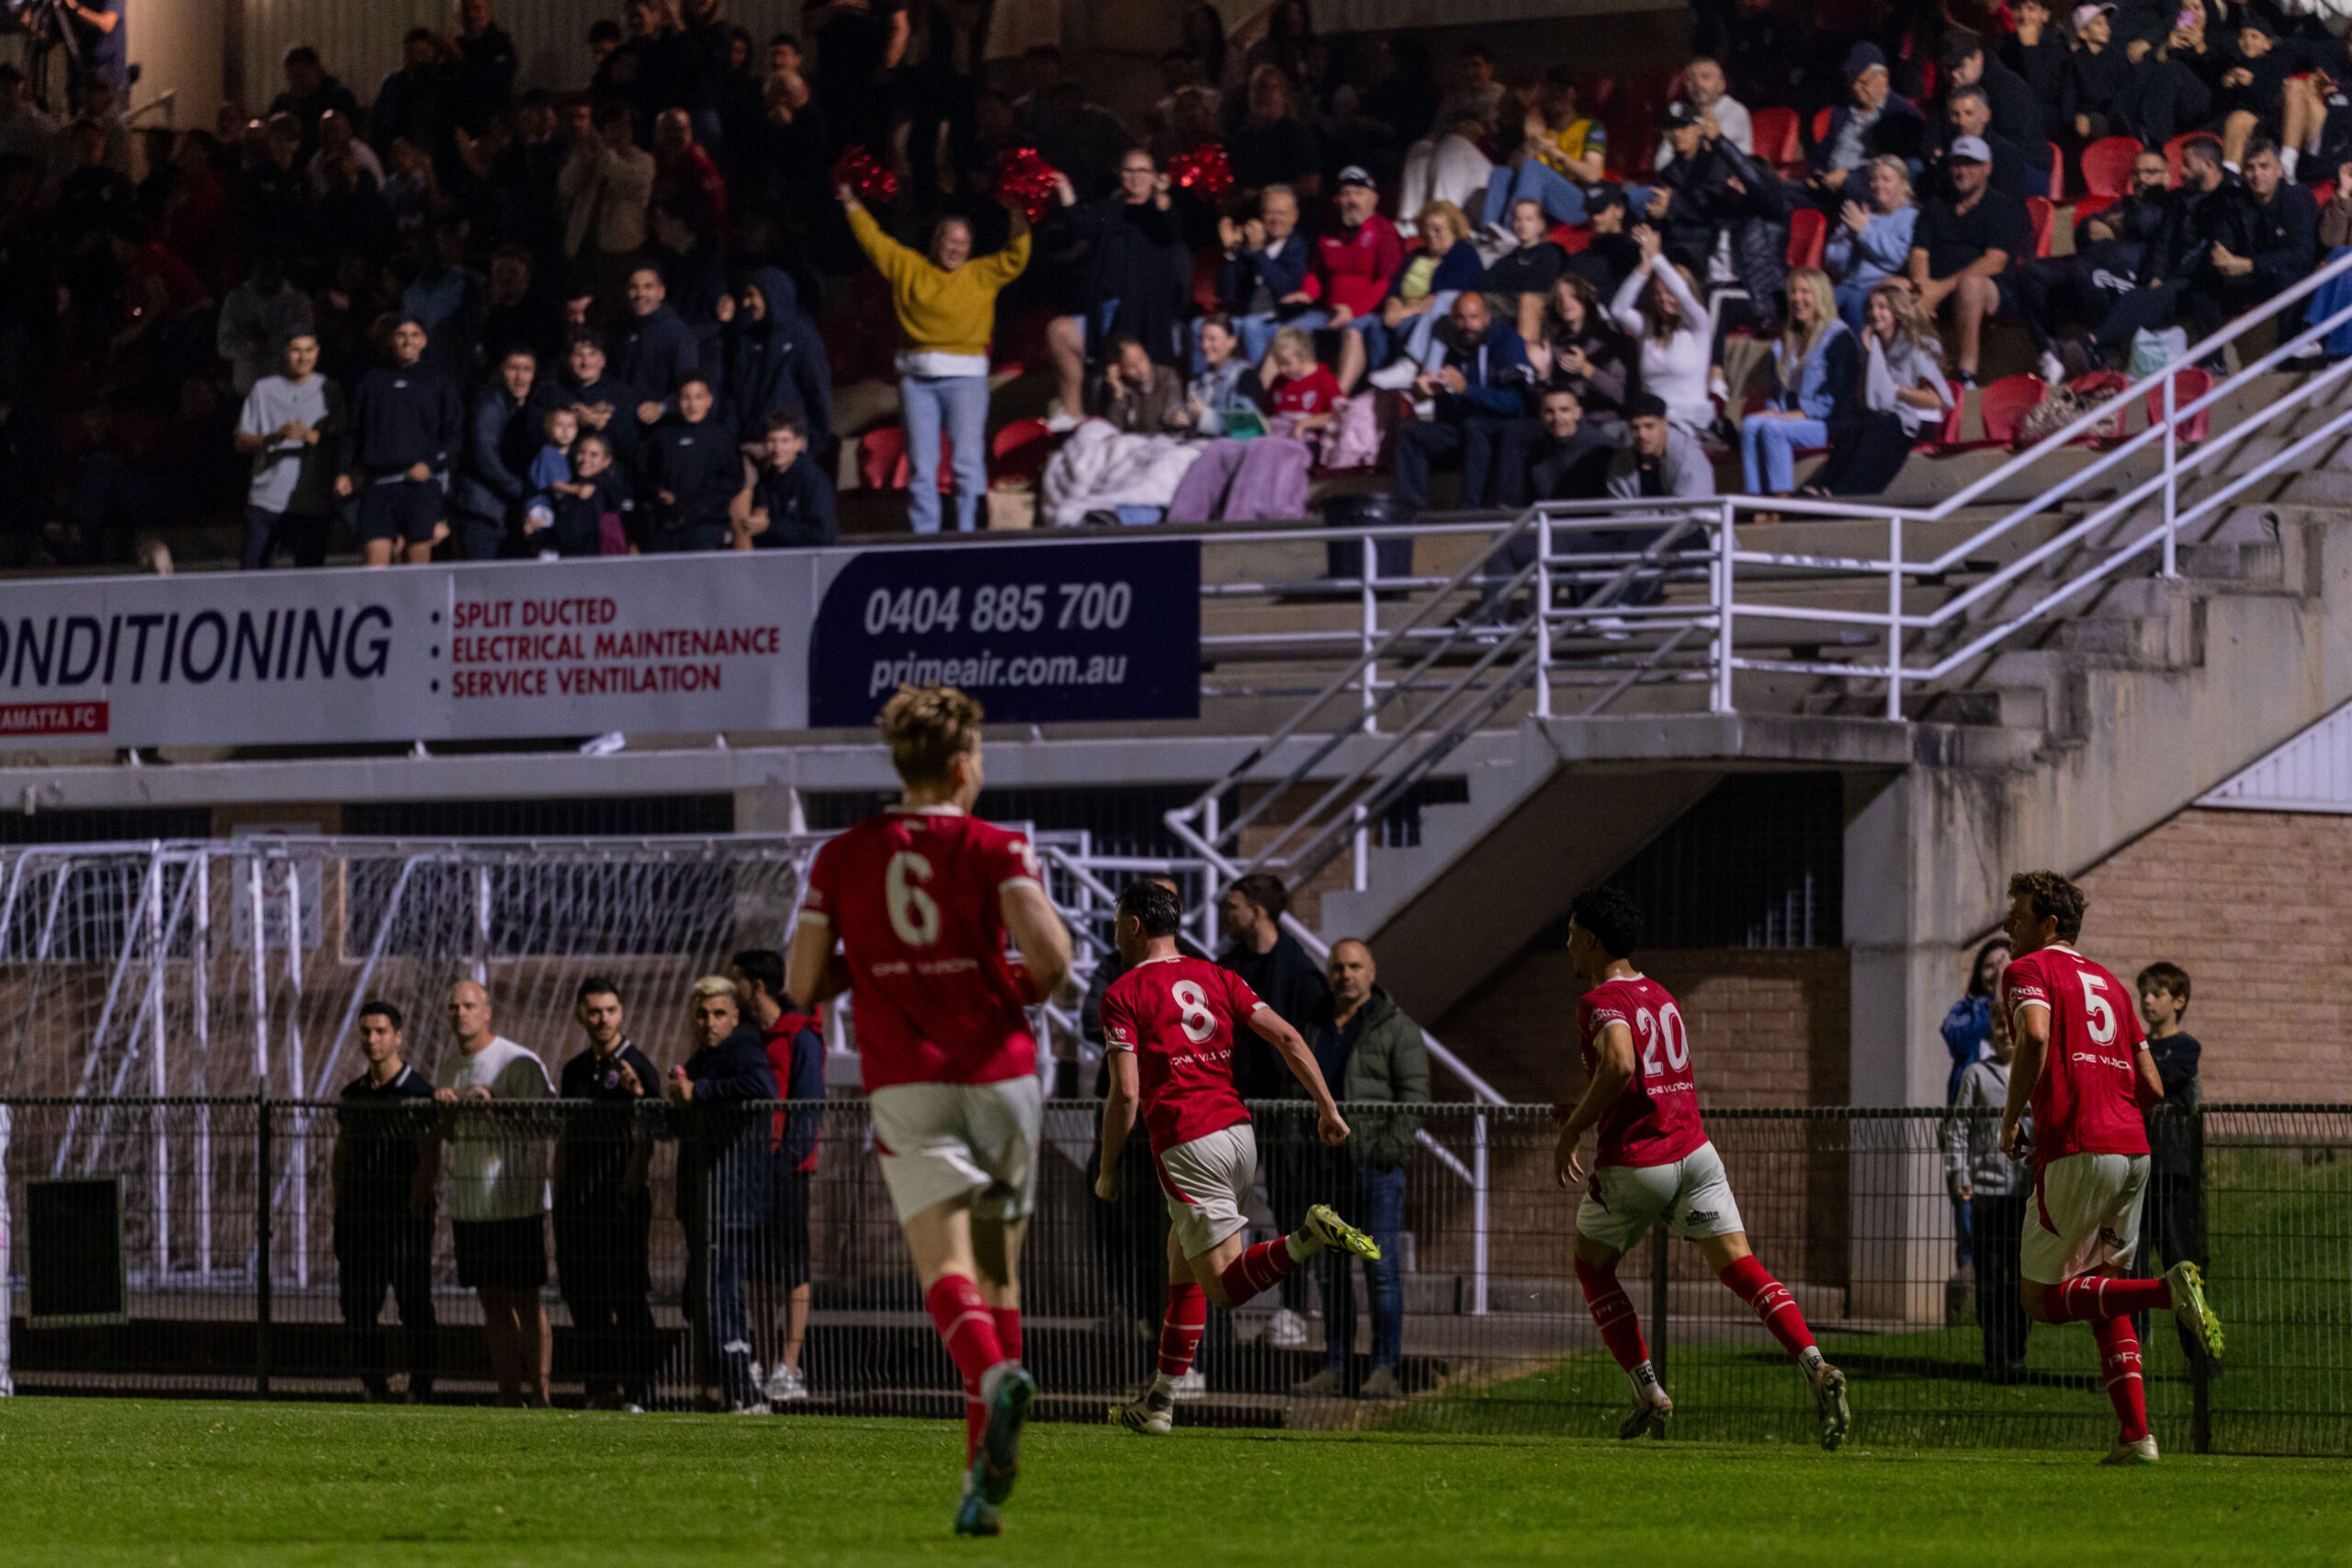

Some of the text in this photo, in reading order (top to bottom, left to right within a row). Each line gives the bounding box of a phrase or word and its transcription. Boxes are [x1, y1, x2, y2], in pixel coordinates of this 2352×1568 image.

[453, 598, 616, 629] SPLIT DUCTED
[865, 581, 1132, 635] 0404 885 700
[0, 605, 392, 686] NDITIONING
[453, 626, 780, 662] ELECTRICAL MAINTENANCE
[453, 663, 721, 698] SERVICE VENTILATION
[869, 649, 1127, 698] primeair.com.au
[0, 706, 96, 729] AMATTA FC
[886, 851, 942, 947] 6
[1172, 979, 1218, 1044] 8
[2076, 970, 2118, 1046] 5
[1635, 1002, 1690, 1078] 20
[2072, 1052, 2097, 1063] ONE
[1646, 1086, 1664, 1095] ONE
